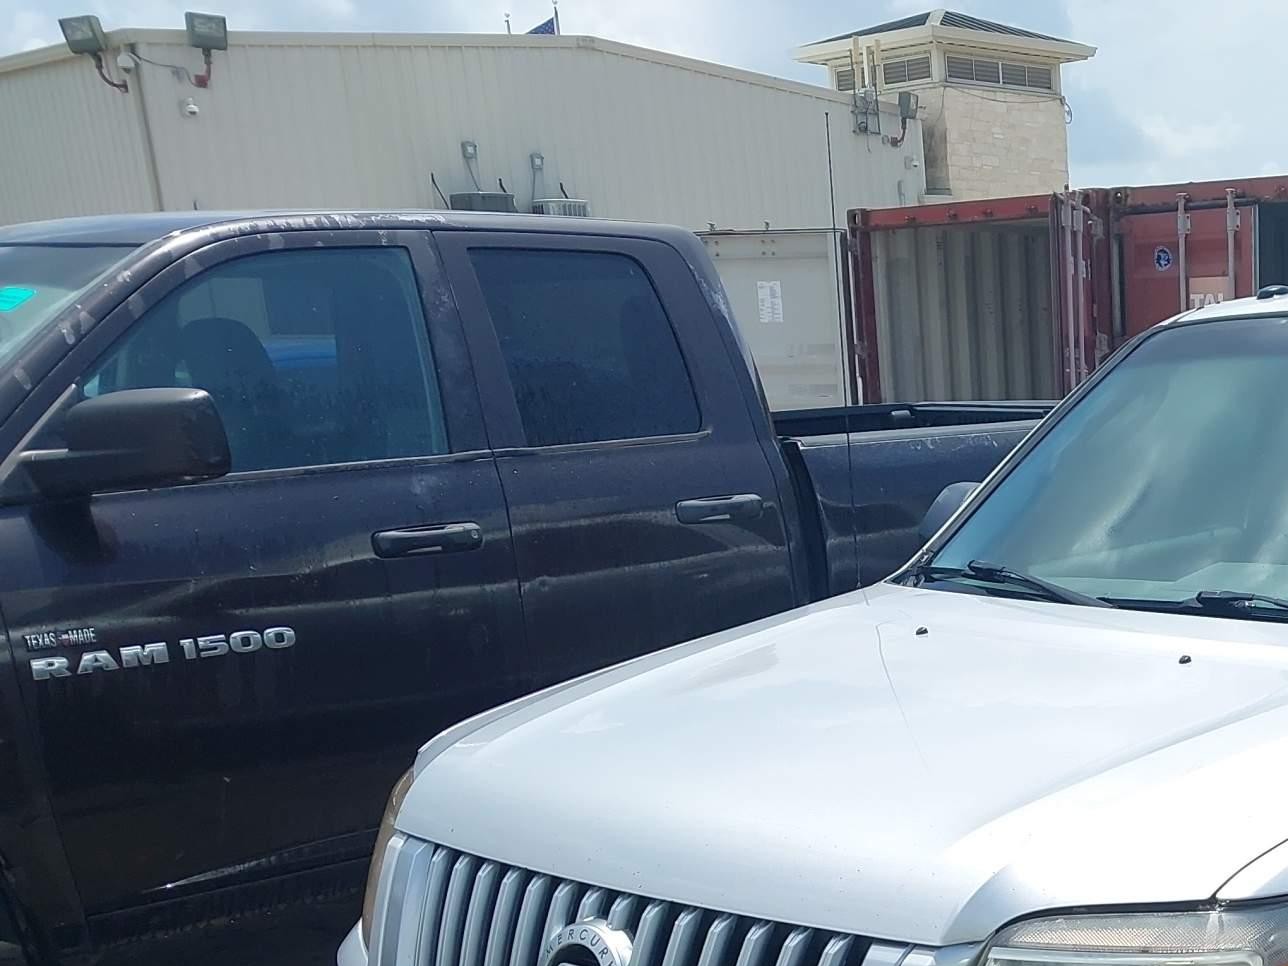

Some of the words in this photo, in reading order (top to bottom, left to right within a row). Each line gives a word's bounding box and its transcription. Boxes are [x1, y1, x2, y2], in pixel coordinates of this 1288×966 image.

[24, 632, 57, 648] TEXAS
[68, 628, 97, 645] MADE
[29, 641, 170, 681] RAM
[179, 626, 297, 660] 1500
